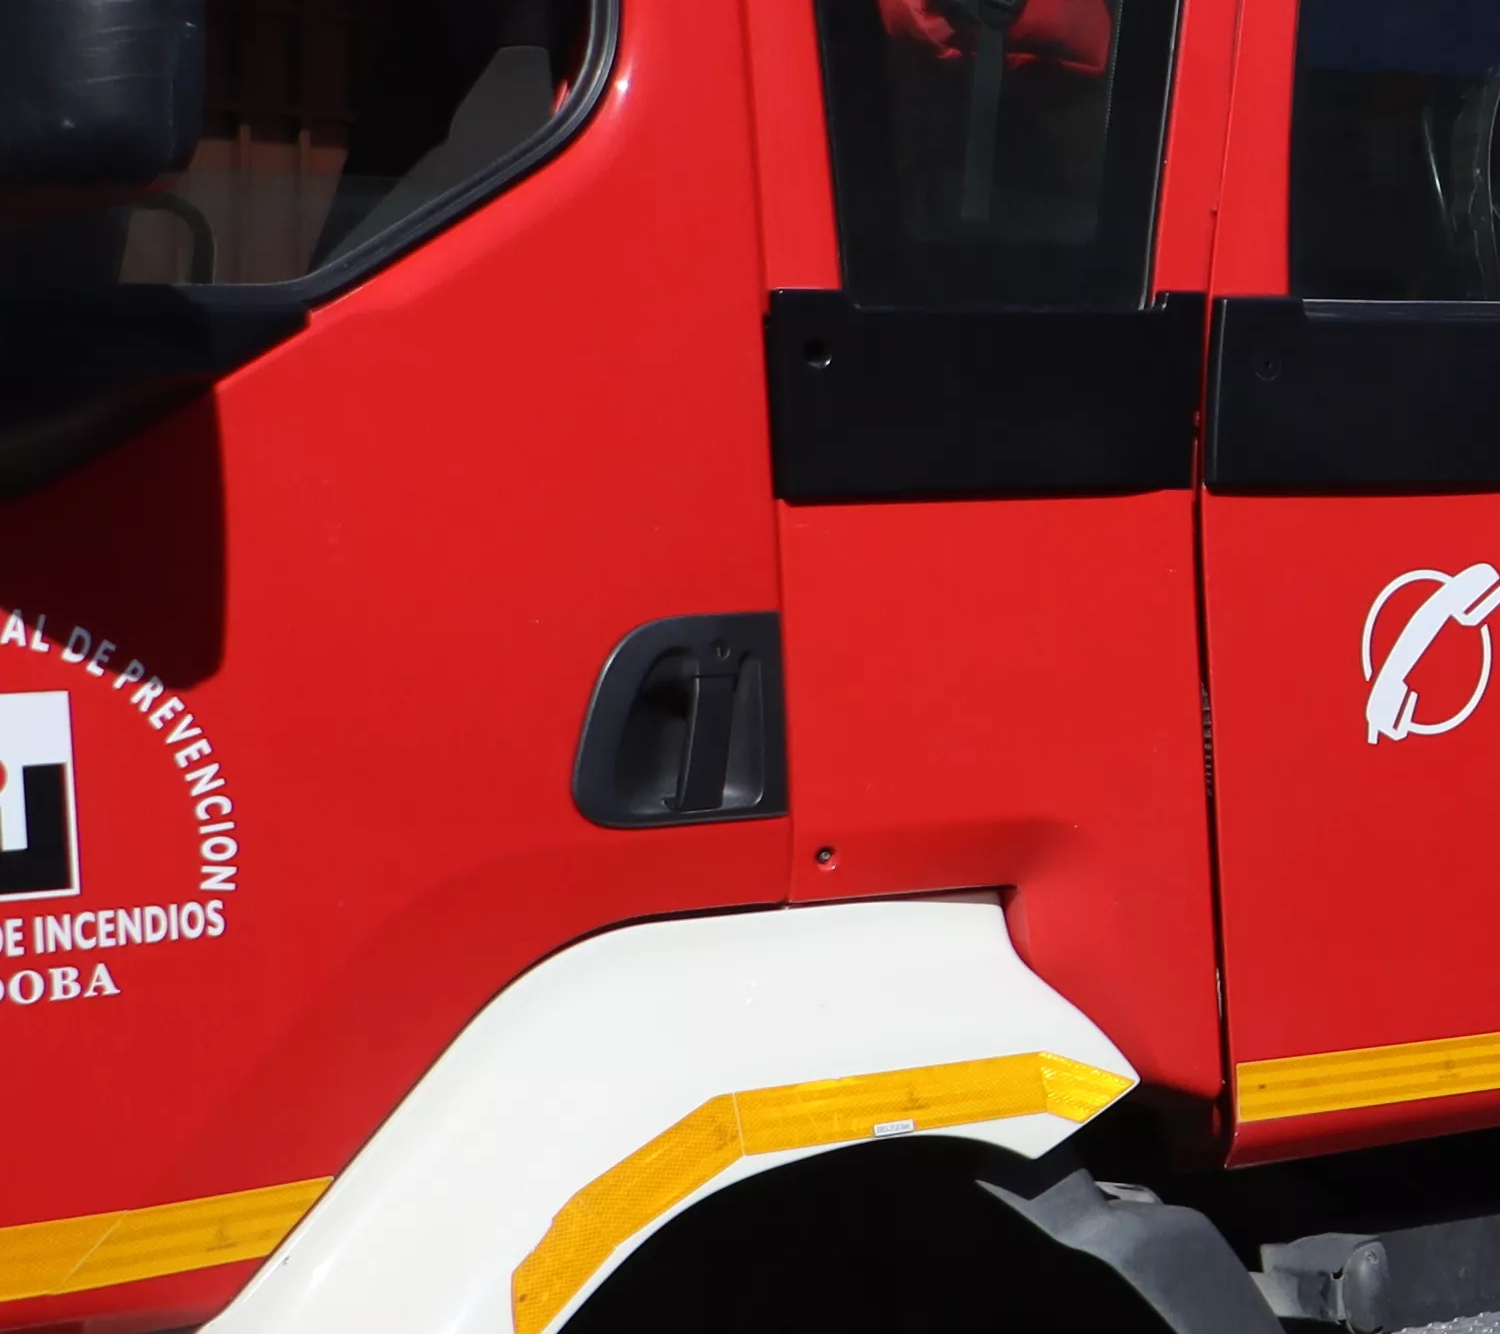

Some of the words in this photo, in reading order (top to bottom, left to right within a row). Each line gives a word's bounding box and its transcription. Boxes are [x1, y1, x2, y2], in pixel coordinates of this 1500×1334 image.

[61, 625, 117, 676] DE
[112, 658, 238, 891] PREVENCION
[0, 918, 25, 957] E
[33, 899, 226, 954] INCENDIOS
[0, 962, 121, 1005] OBA
